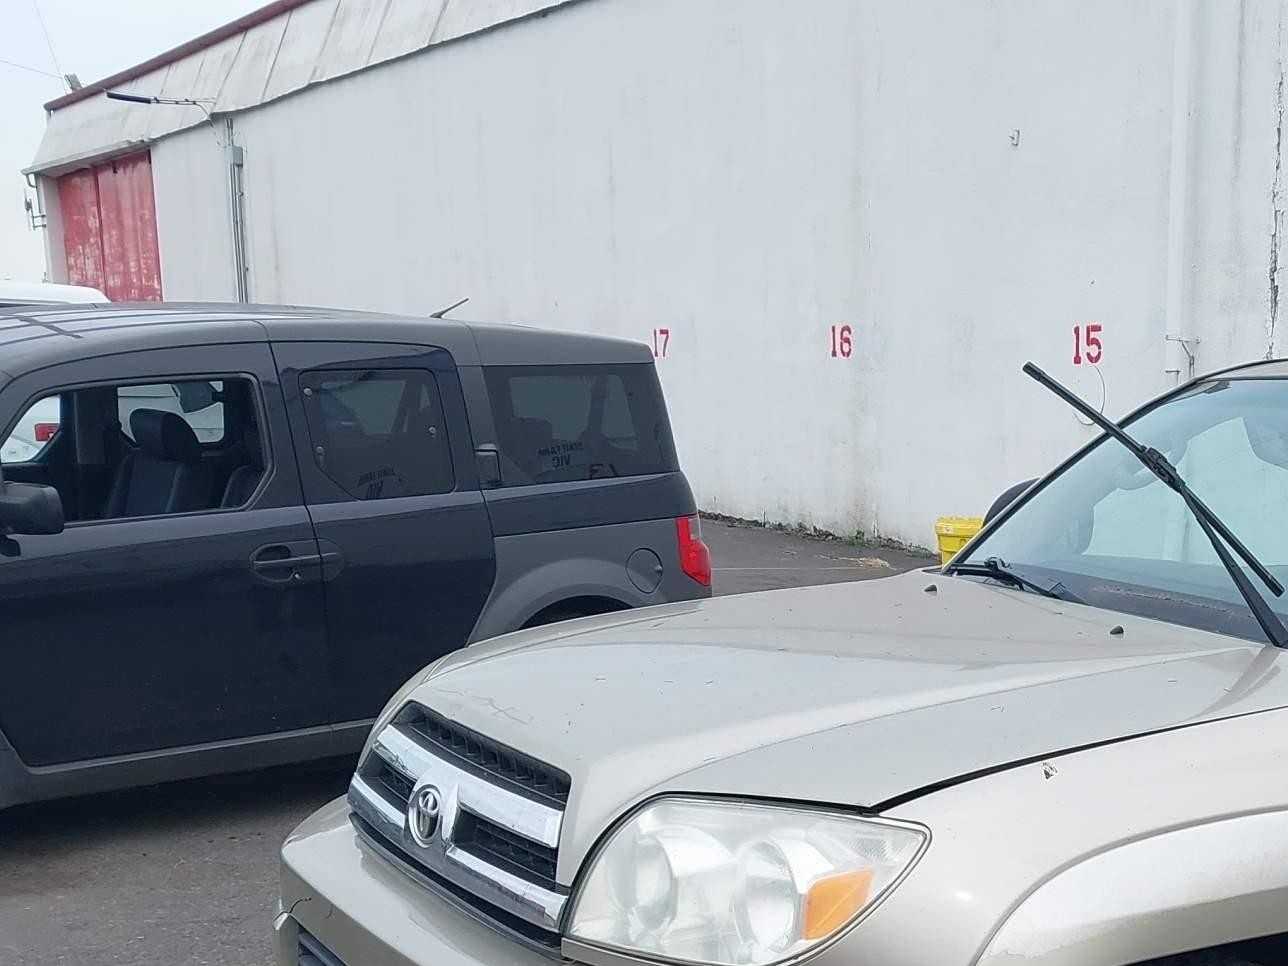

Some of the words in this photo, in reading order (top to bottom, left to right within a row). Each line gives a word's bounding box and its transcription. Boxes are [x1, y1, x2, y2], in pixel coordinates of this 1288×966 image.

[653, 328, 670, 358] 17
[831, 324, 852, 358] 16
[1073, 324, 1102, 365] 15
